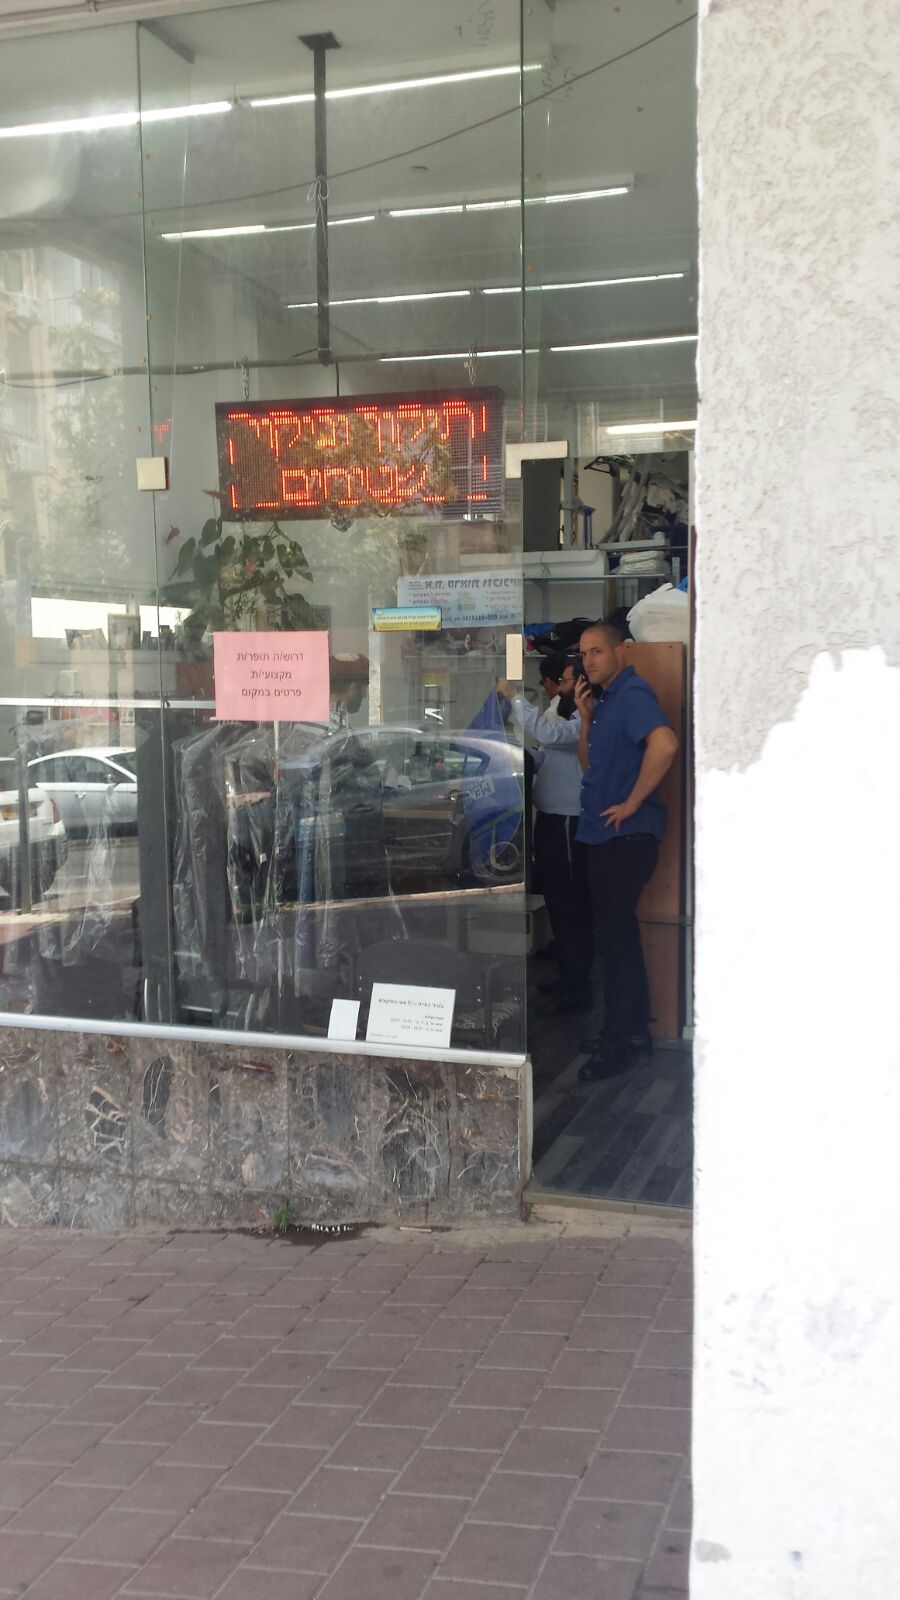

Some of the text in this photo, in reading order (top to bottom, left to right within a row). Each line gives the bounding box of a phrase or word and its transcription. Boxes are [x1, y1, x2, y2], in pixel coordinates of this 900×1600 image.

[364, 406, 475, 453] תיקון
[281, 464, 429, 501] שטיחים
[237, 651, 304, 661] דרוש/ה תופר/ת
[250, 669, 292, 681] מקצועי/ת
[241, 688, 302, 699] פרטים במקום
